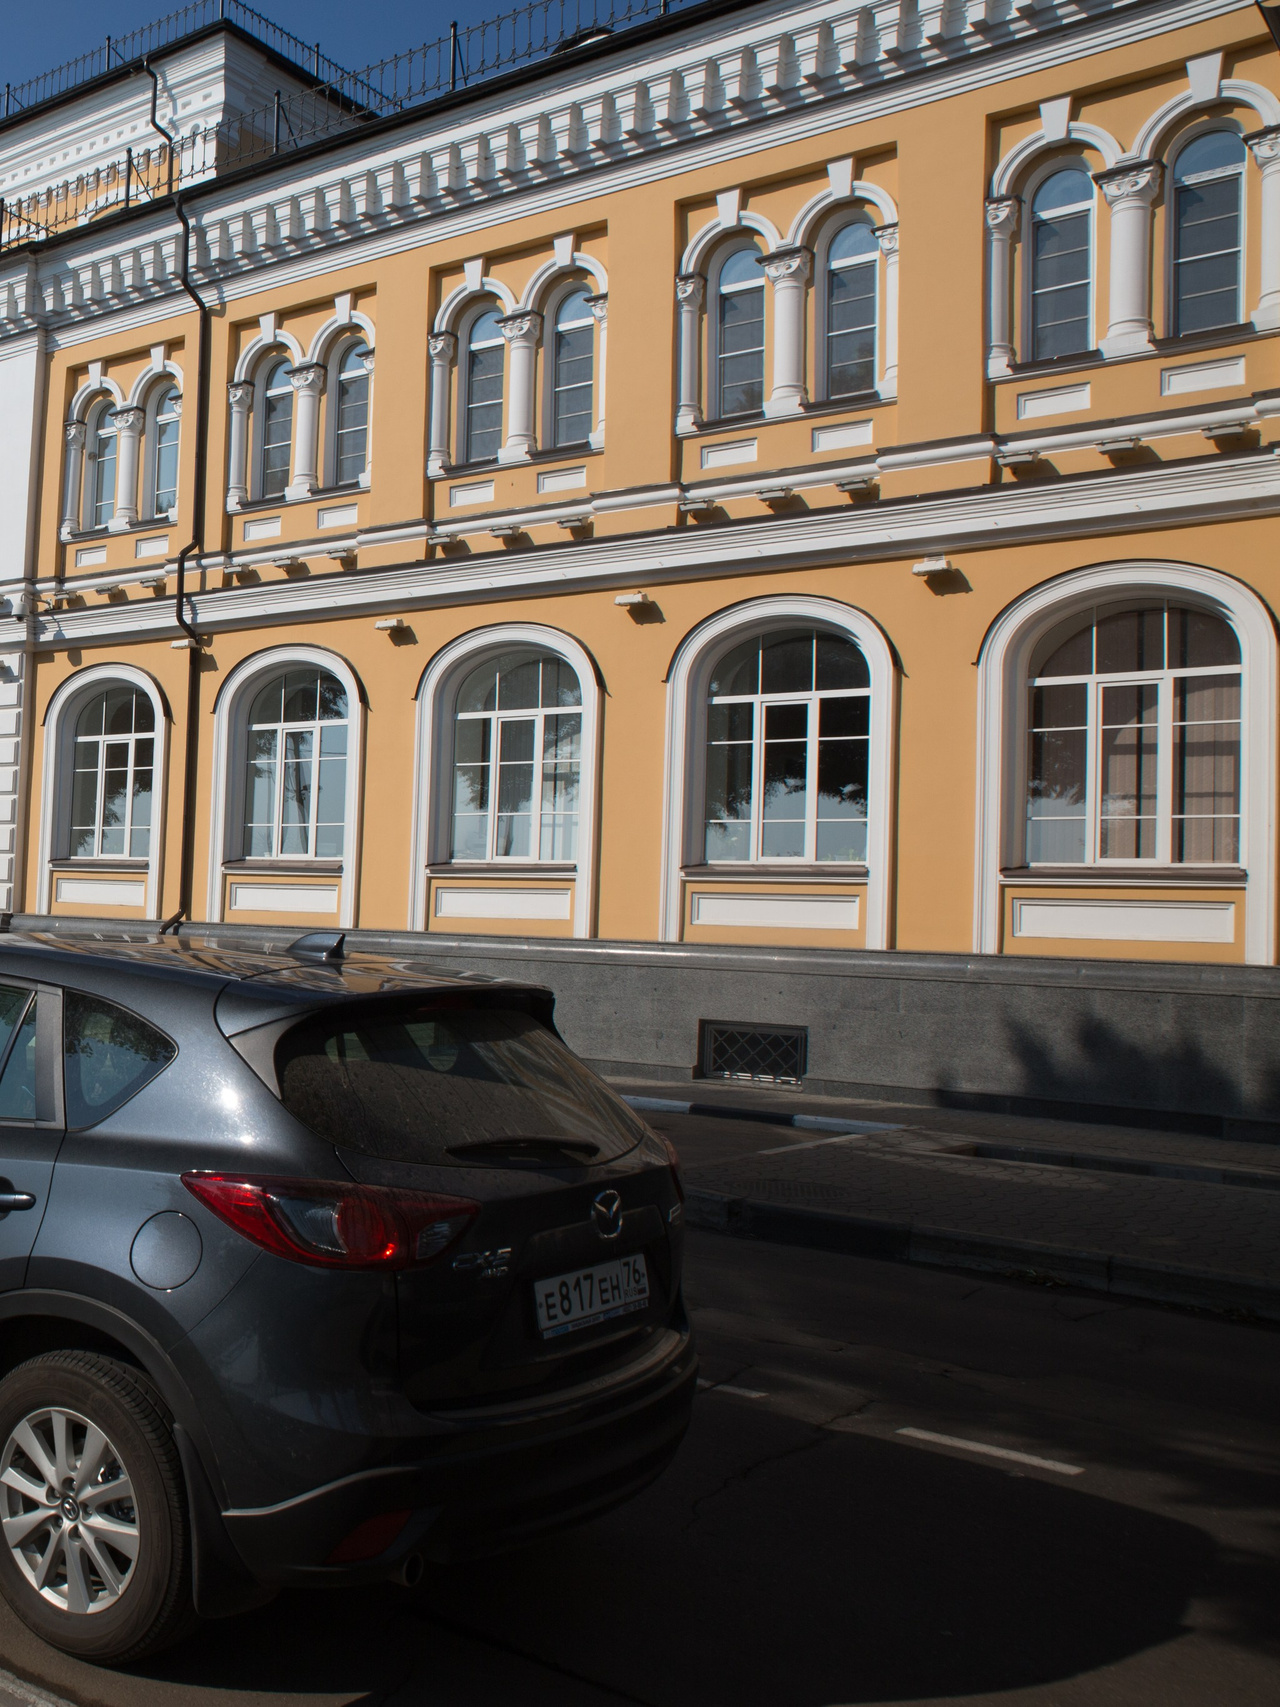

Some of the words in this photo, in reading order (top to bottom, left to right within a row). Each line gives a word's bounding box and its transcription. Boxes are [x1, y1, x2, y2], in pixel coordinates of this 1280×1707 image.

[452, 1248, 512, 1269] CX-5
[623, 1258, 641, 1287] 76
[624, 1287, 638, 1298] RUS
